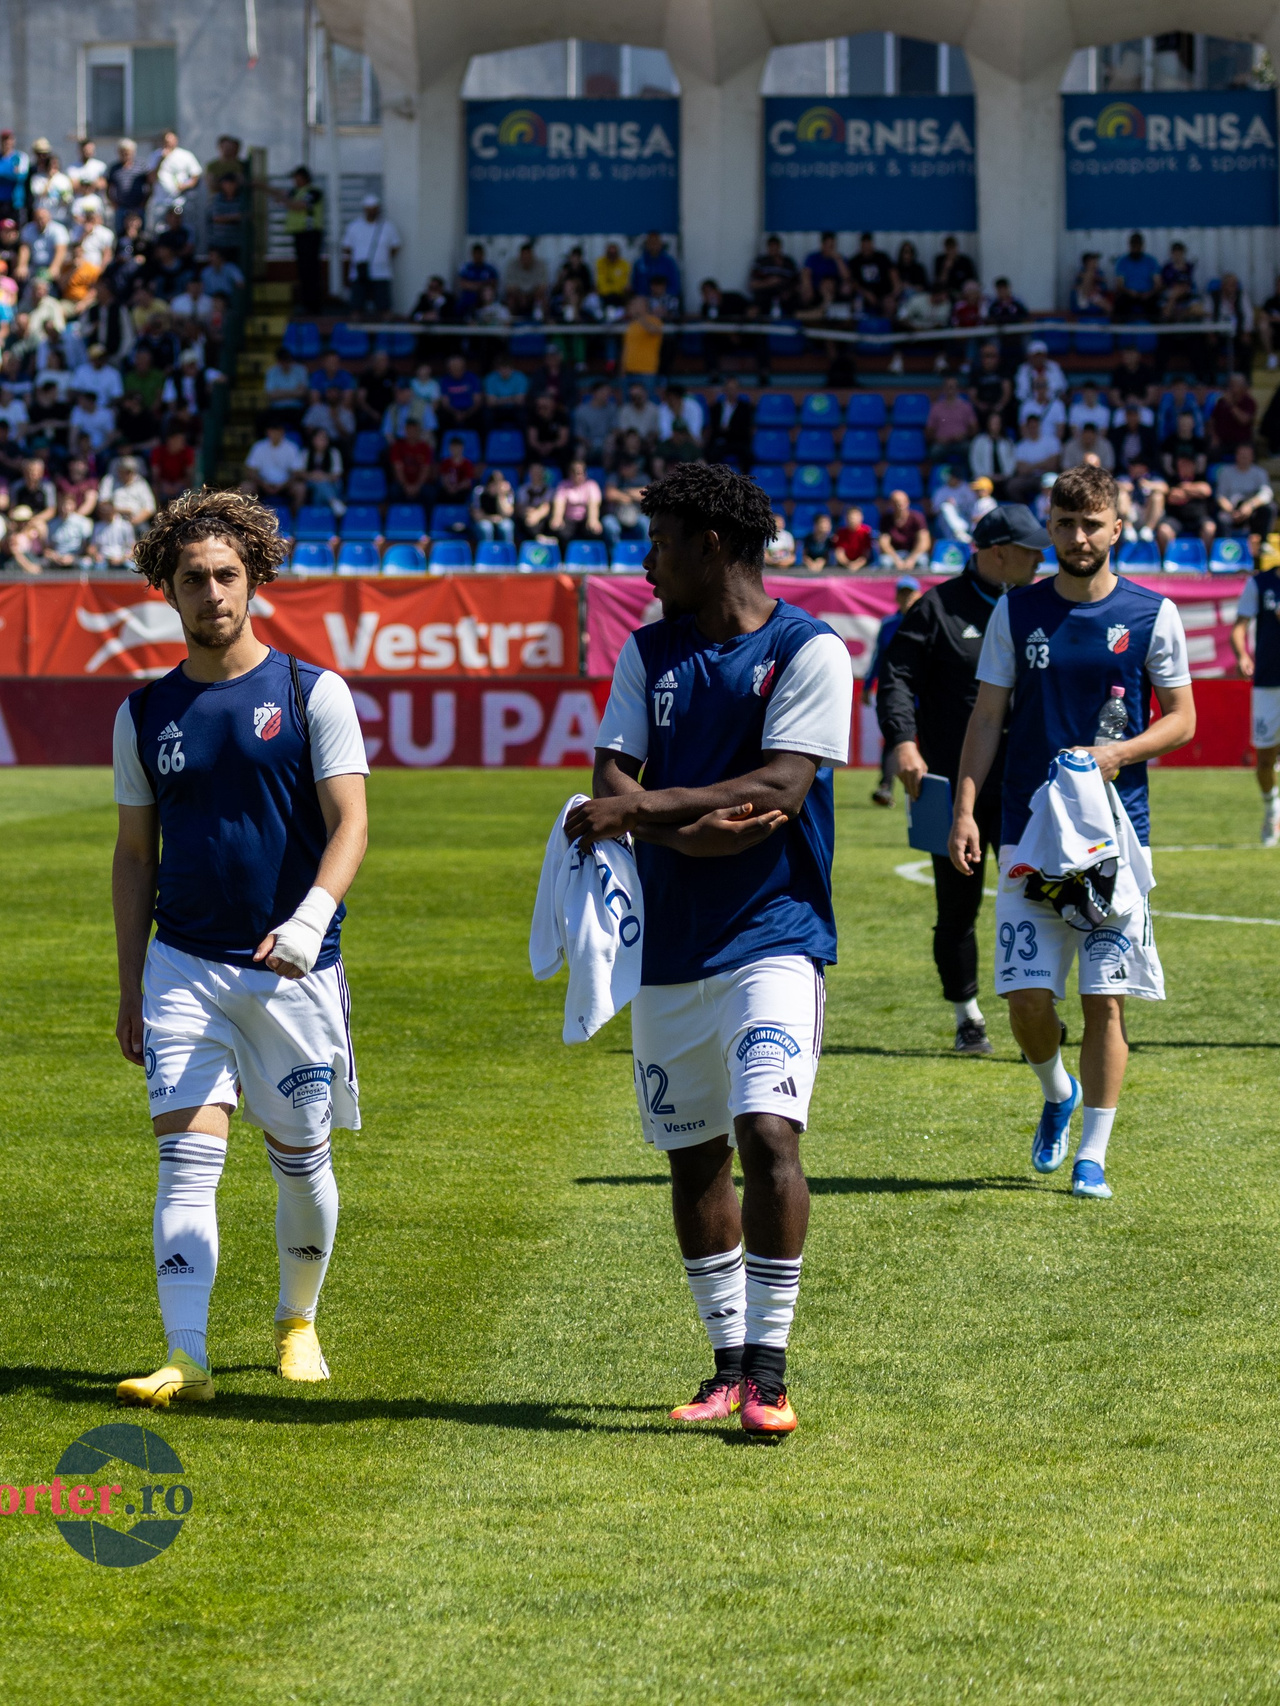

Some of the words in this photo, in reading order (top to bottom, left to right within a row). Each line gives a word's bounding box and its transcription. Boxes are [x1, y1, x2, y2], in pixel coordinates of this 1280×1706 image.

[587, 161, 602, 180] &
[1186, 154, 1203, 172] &
[323, 612, 565, 671] Vestra
[1026, 644, 1050, 669] 93
[654, 681, 678, 690] adidas
[653, 691, 674, 726] 12
[157, 730, 183, 742] adidas
[157, 741, 185, 775] 66
[1000, 920, 1039, 963] 93
[1023, 969, 1051, 977] Vestra
[737, 1039, 750, 1057] FIVE
[750, 1030, 798, 1055] CONTINENTS
[280, 1077, 297, 1094] FIVE
[637, 1058, 676, 1115] 12
[663, 1119, 707, 1133] Vestra
[287, 1246, 328, 1262] adidas
[157, 1266, 195, 1277] adidas
